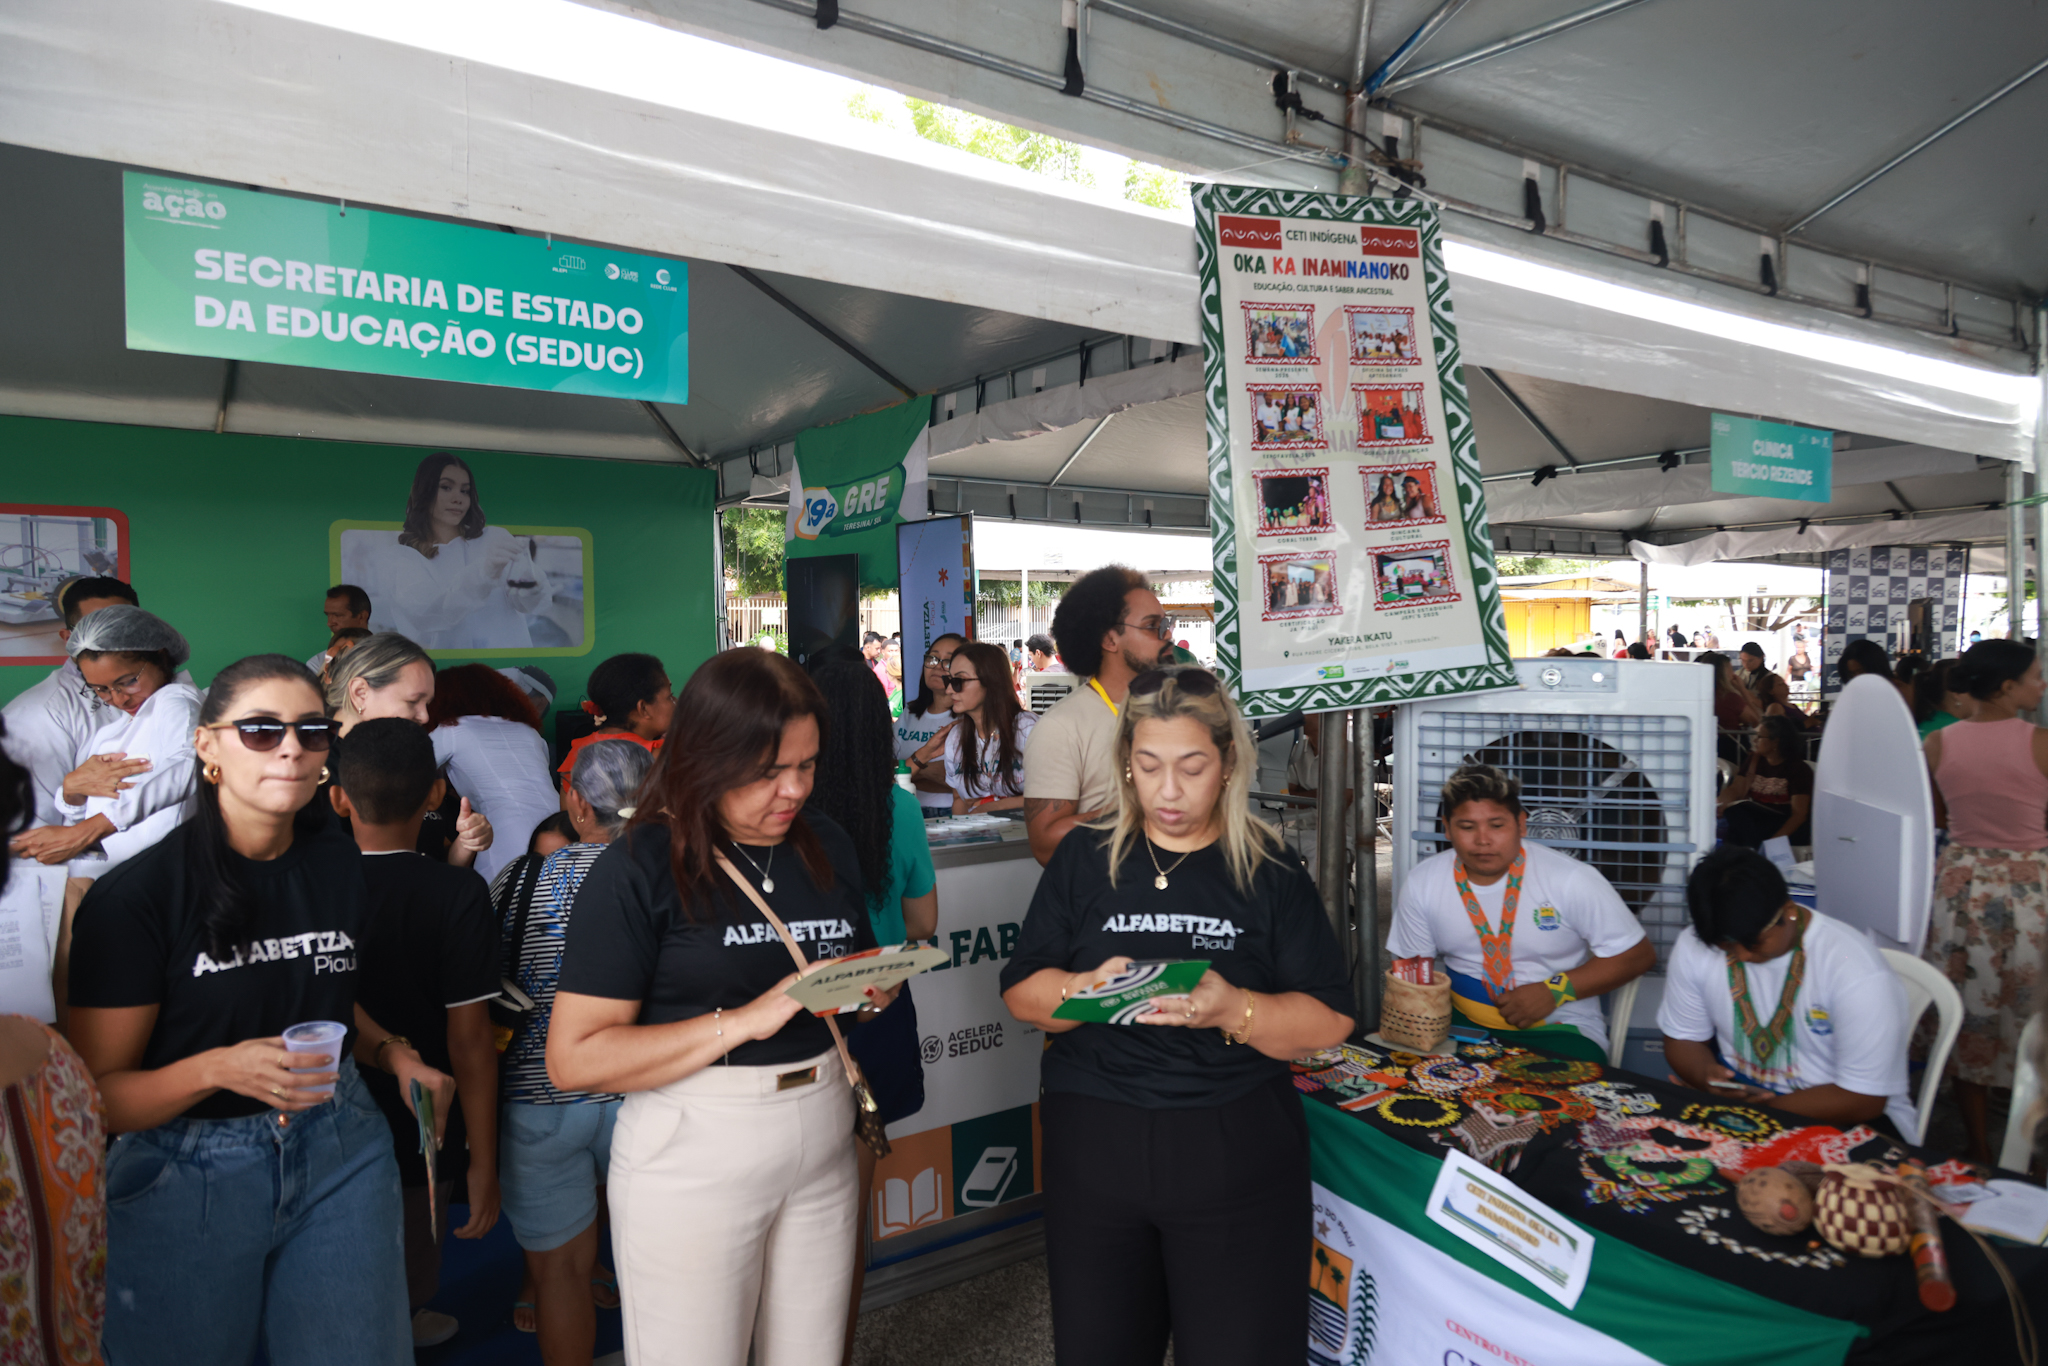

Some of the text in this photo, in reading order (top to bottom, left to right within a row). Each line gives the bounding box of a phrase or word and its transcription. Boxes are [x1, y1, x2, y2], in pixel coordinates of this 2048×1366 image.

[1286, 229, 1358, 246] CETI INDÍGENA
[1234, 253, 1410, 281] OKA KA INAMINANOKO
[194, 248, 644, 336] SECRETARIA DE ESTADO
[1296, 284, 1328, 292] CULTURA
[1330, 285, 1334, 293] E
[1335, 286, 1354, 294] SABER
[1356, 287, 1394, 296] ANCESTRAL
[194, 295, 644, 379] DA EDUCAÇÃO (SEDUC)
[843, 476, 891, 518] GRE
[806, 498, 836, 528] 19a
[1363, 631, 1392, 643] IKATU
[723, 919, 854, 946] ALFAETIZA
[1102, 913, 1237, 938] ALFABETIZA
[907, 920, 1026, 974] LFAB
[1192, 934, 1236, 951] Piauí
[314, 953, 357, 976] Piauí
[810, 960, 915, 988] ALFABETIZA
[947, 1022, 1004, 1044] ACELERA
[948, 1033, 1004, 1059] SEDUC
[1445, 1318, 1501, 1357] CENTRO
